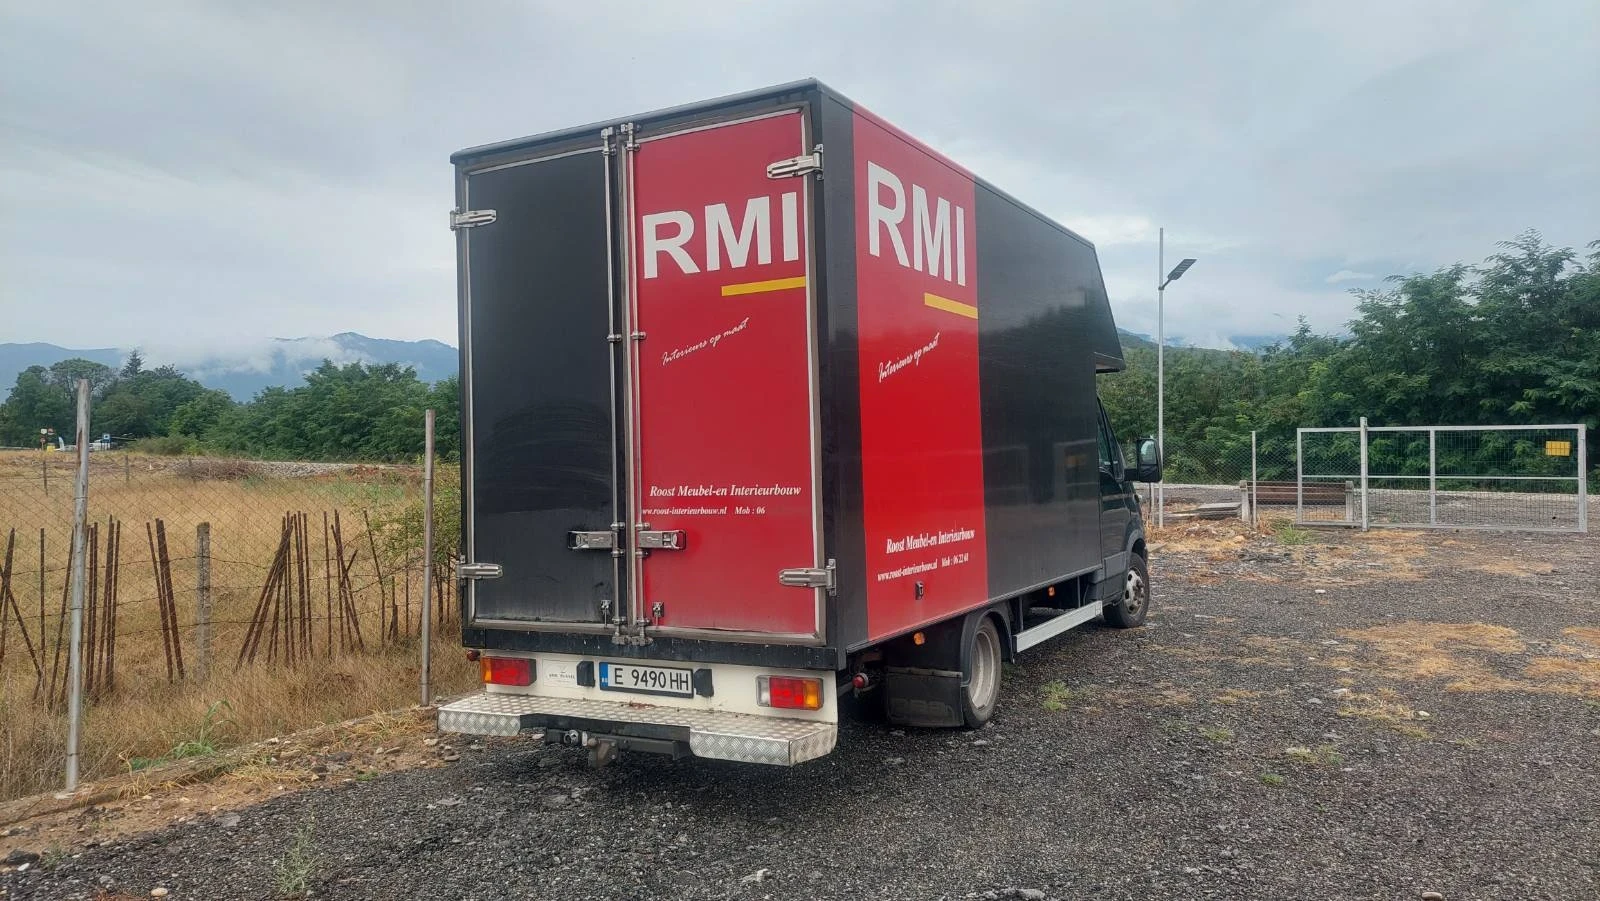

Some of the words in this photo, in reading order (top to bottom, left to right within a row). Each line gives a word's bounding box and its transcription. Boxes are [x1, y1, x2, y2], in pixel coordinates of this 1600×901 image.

[642, 191, 799, 279] RMI
[867, 160, 966, 287] RMI
[709, 334, 721, 348] op
[722, 317, 750, 338] maat
[914, 348, 922, 367] op
[923, 332, 940, 354] maat
[650, 485, 675, 497] Roost
[677, 485, 728, 497] Meubel-en
[730, 484, 802, 496] Interieurbouw
[735, 506, 750, 515] Mob
[756, 506, 766, 515] 06
[886, 538, 905, 554] Roost
[906, 532, 937, 552] Meubel-en
[938, 527, 976, 545] Interieurbouw
[614, 667, 623, 685] E
[631, 669, 666, 689] 9490
[669, 671, 689, 691] HH
